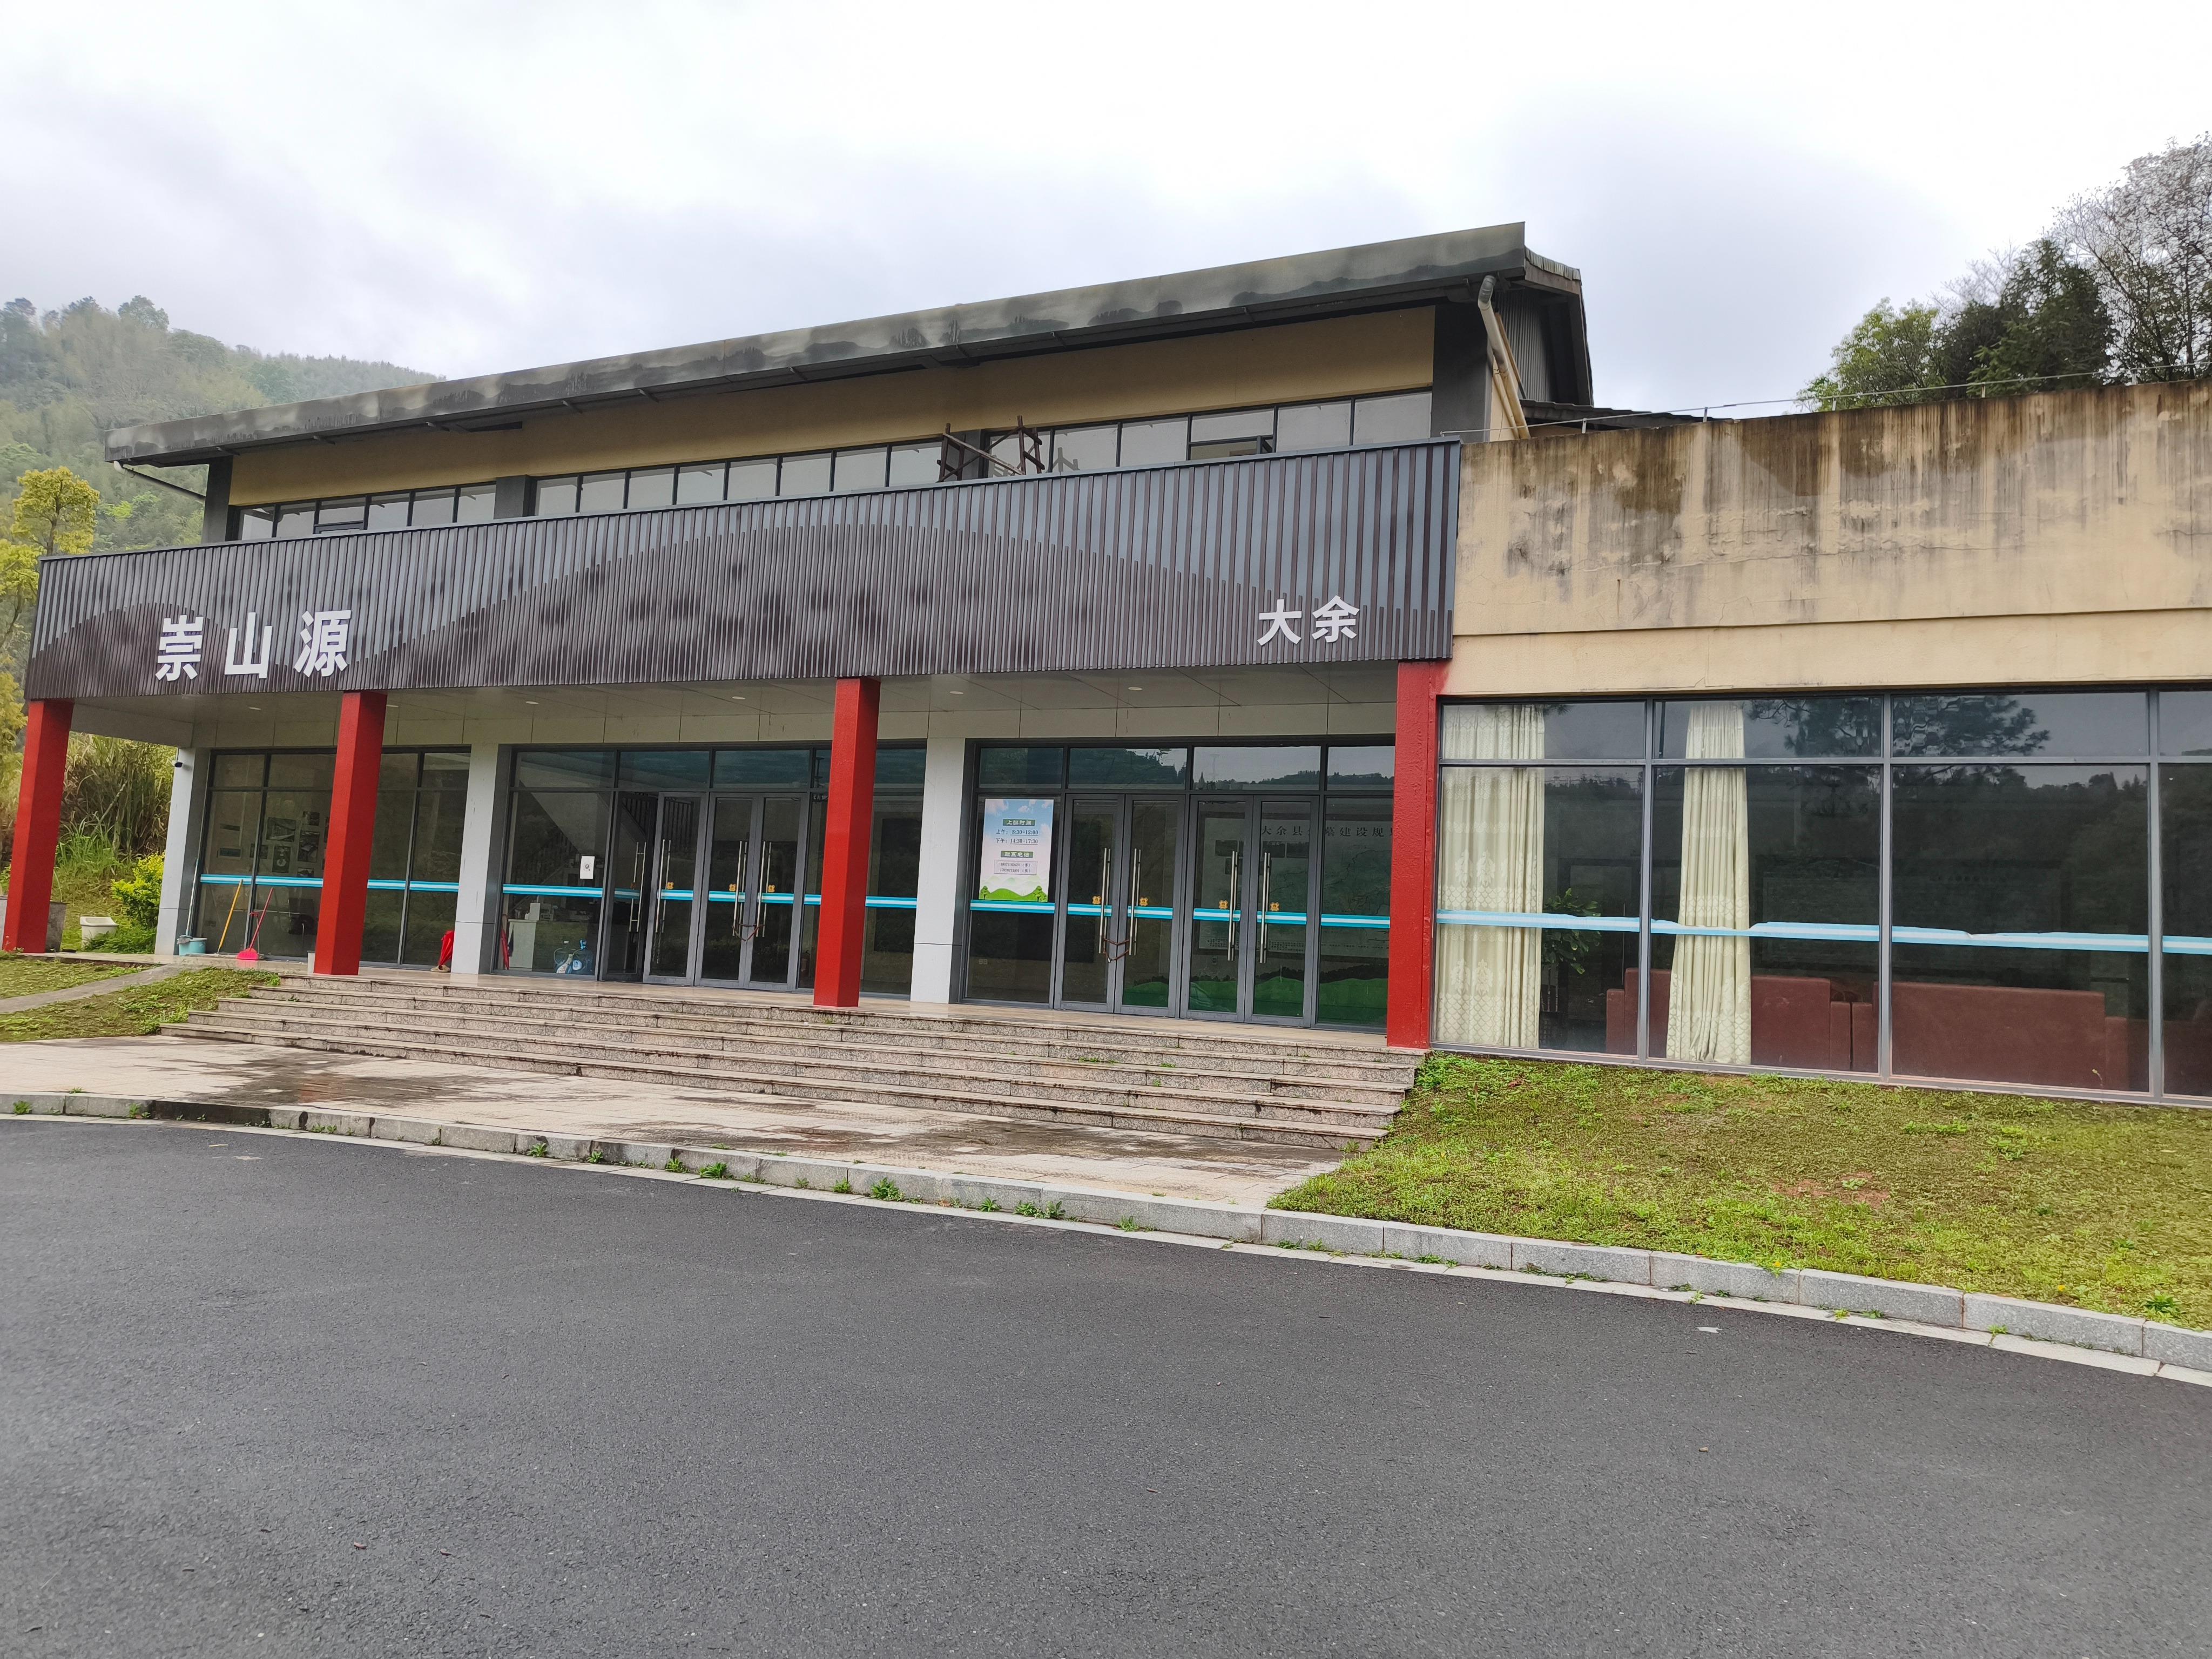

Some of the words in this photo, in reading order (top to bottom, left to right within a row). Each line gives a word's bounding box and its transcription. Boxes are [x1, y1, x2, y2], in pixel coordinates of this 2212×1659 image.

[155, 610, 352, 682] 崇山源
[1257, 595, 1360, 646] 大余
